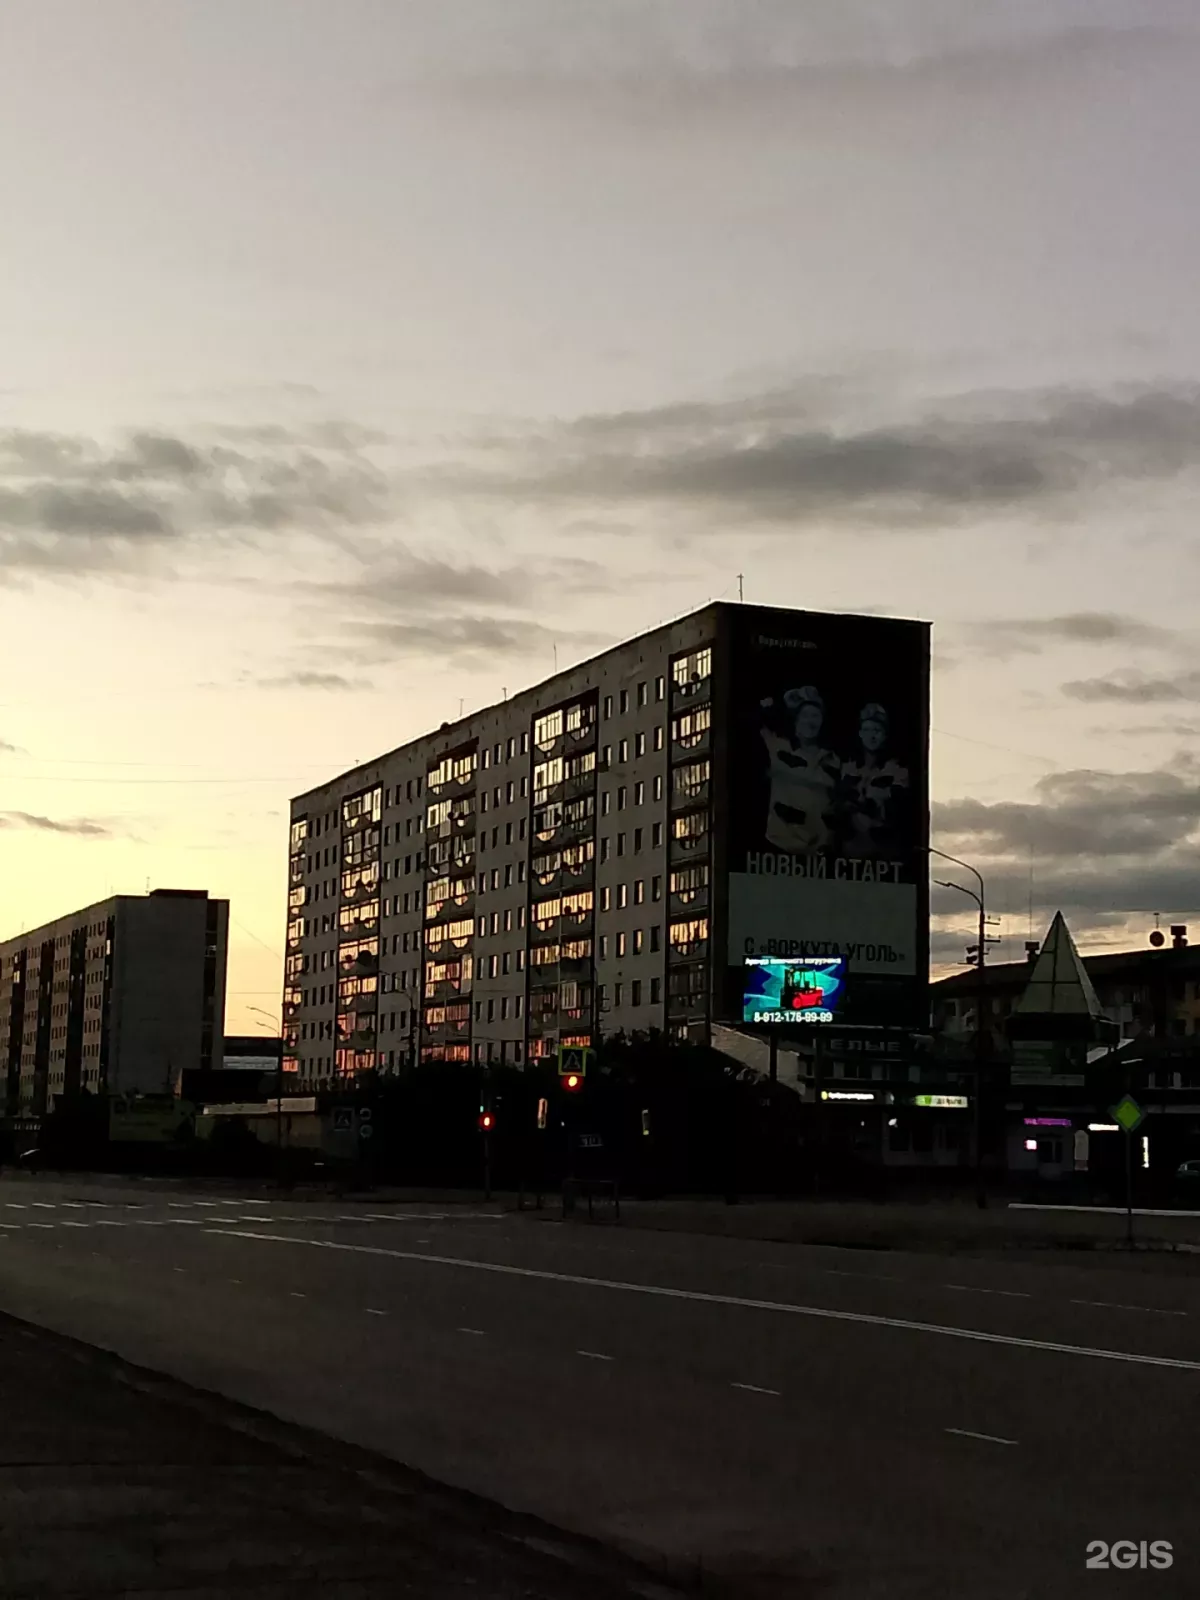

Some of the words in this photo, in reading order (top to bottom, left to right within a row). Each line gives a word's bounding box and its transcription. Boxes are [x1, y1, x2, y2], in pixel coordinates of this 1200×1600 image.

[746, 850, 828, 880] НОВЫЙ
[834, 857, 904, 884] СТАРТ
[743, 936, 755, 955] С
